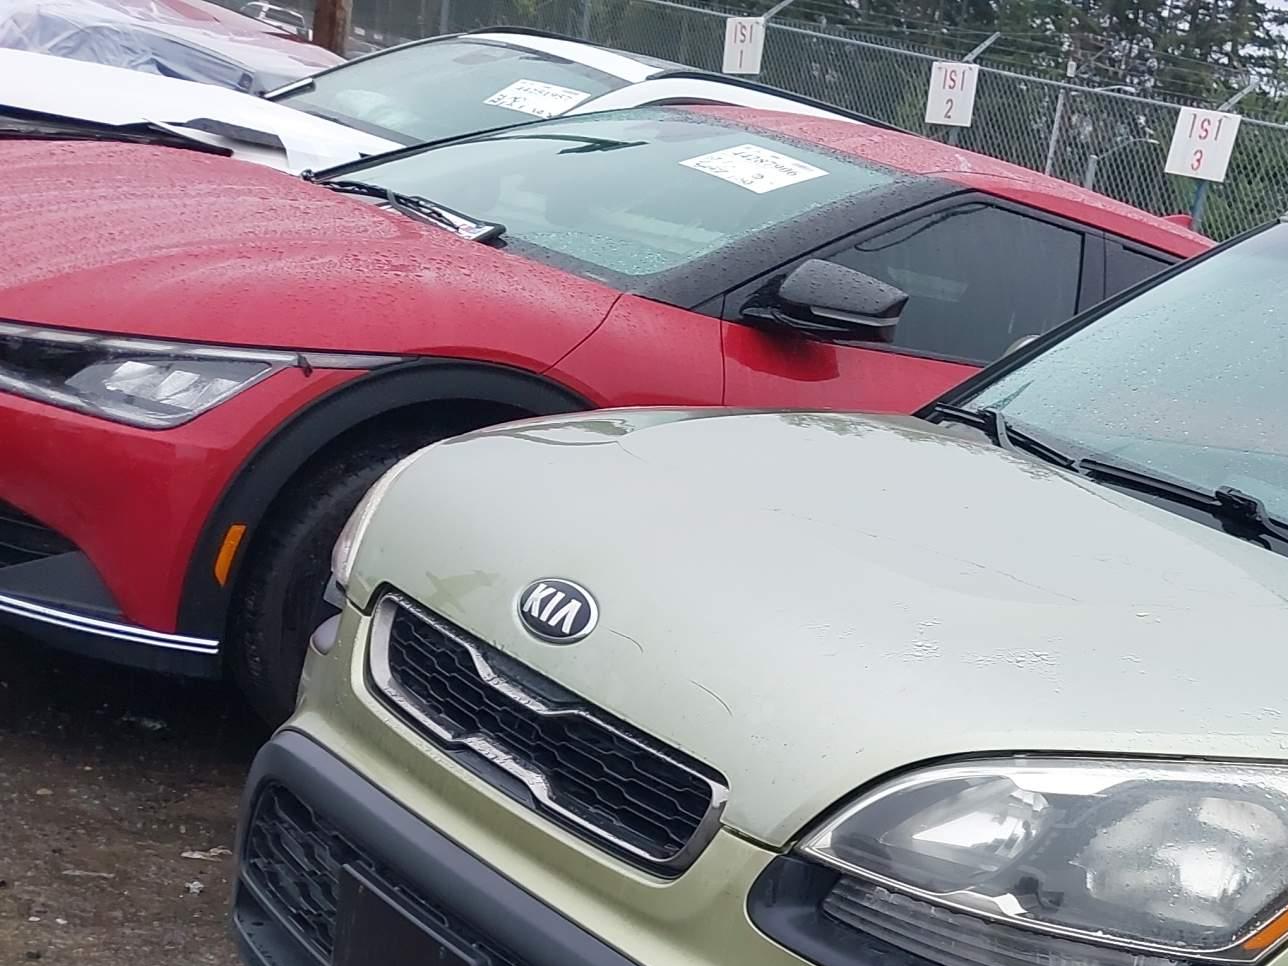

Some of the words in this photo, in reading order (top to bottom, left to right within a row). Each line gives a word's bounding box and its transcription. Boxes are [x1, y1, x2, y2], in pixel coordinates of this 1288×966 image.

[943, 98, 954, 119] 2
[1190, 149, 1203, 172] 3
[522, 582, 582, 635] KIA
